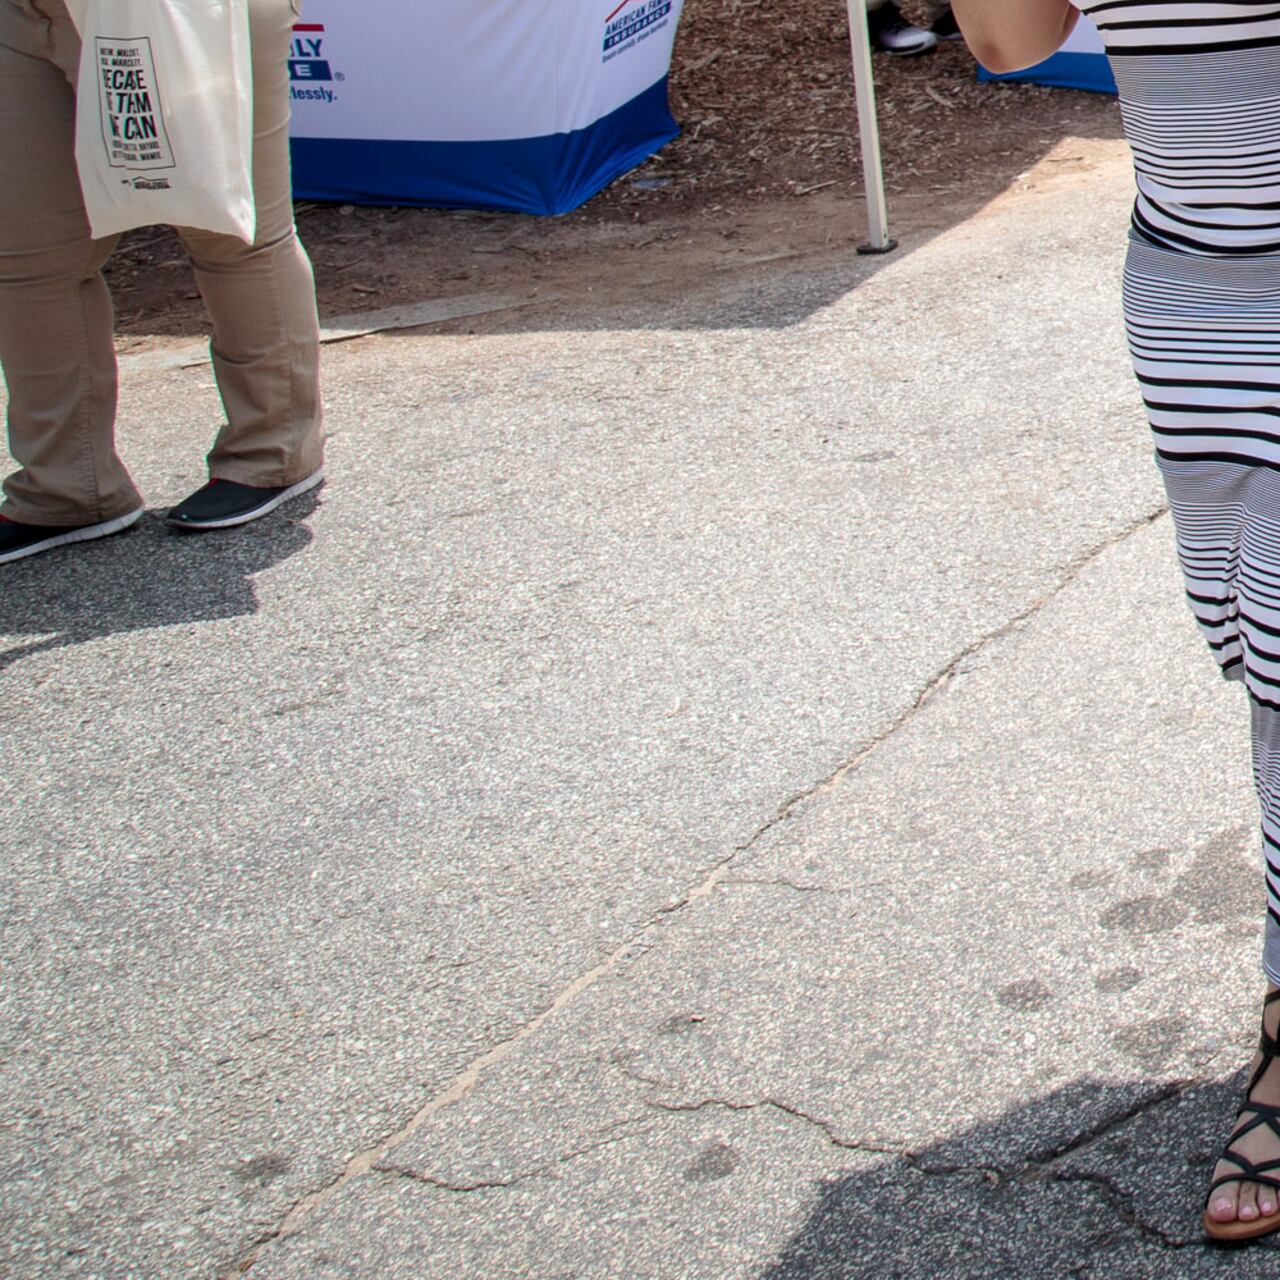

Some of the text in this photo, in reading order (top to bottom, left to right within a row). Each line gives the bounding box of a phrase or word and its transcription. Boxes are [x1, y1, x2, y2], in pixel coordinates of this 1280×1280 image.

[605, 3, 647, 37] AMERICAN
[608, 4, 668, 48] INSURANCE
[290, 86, 338, 103] lessly.
